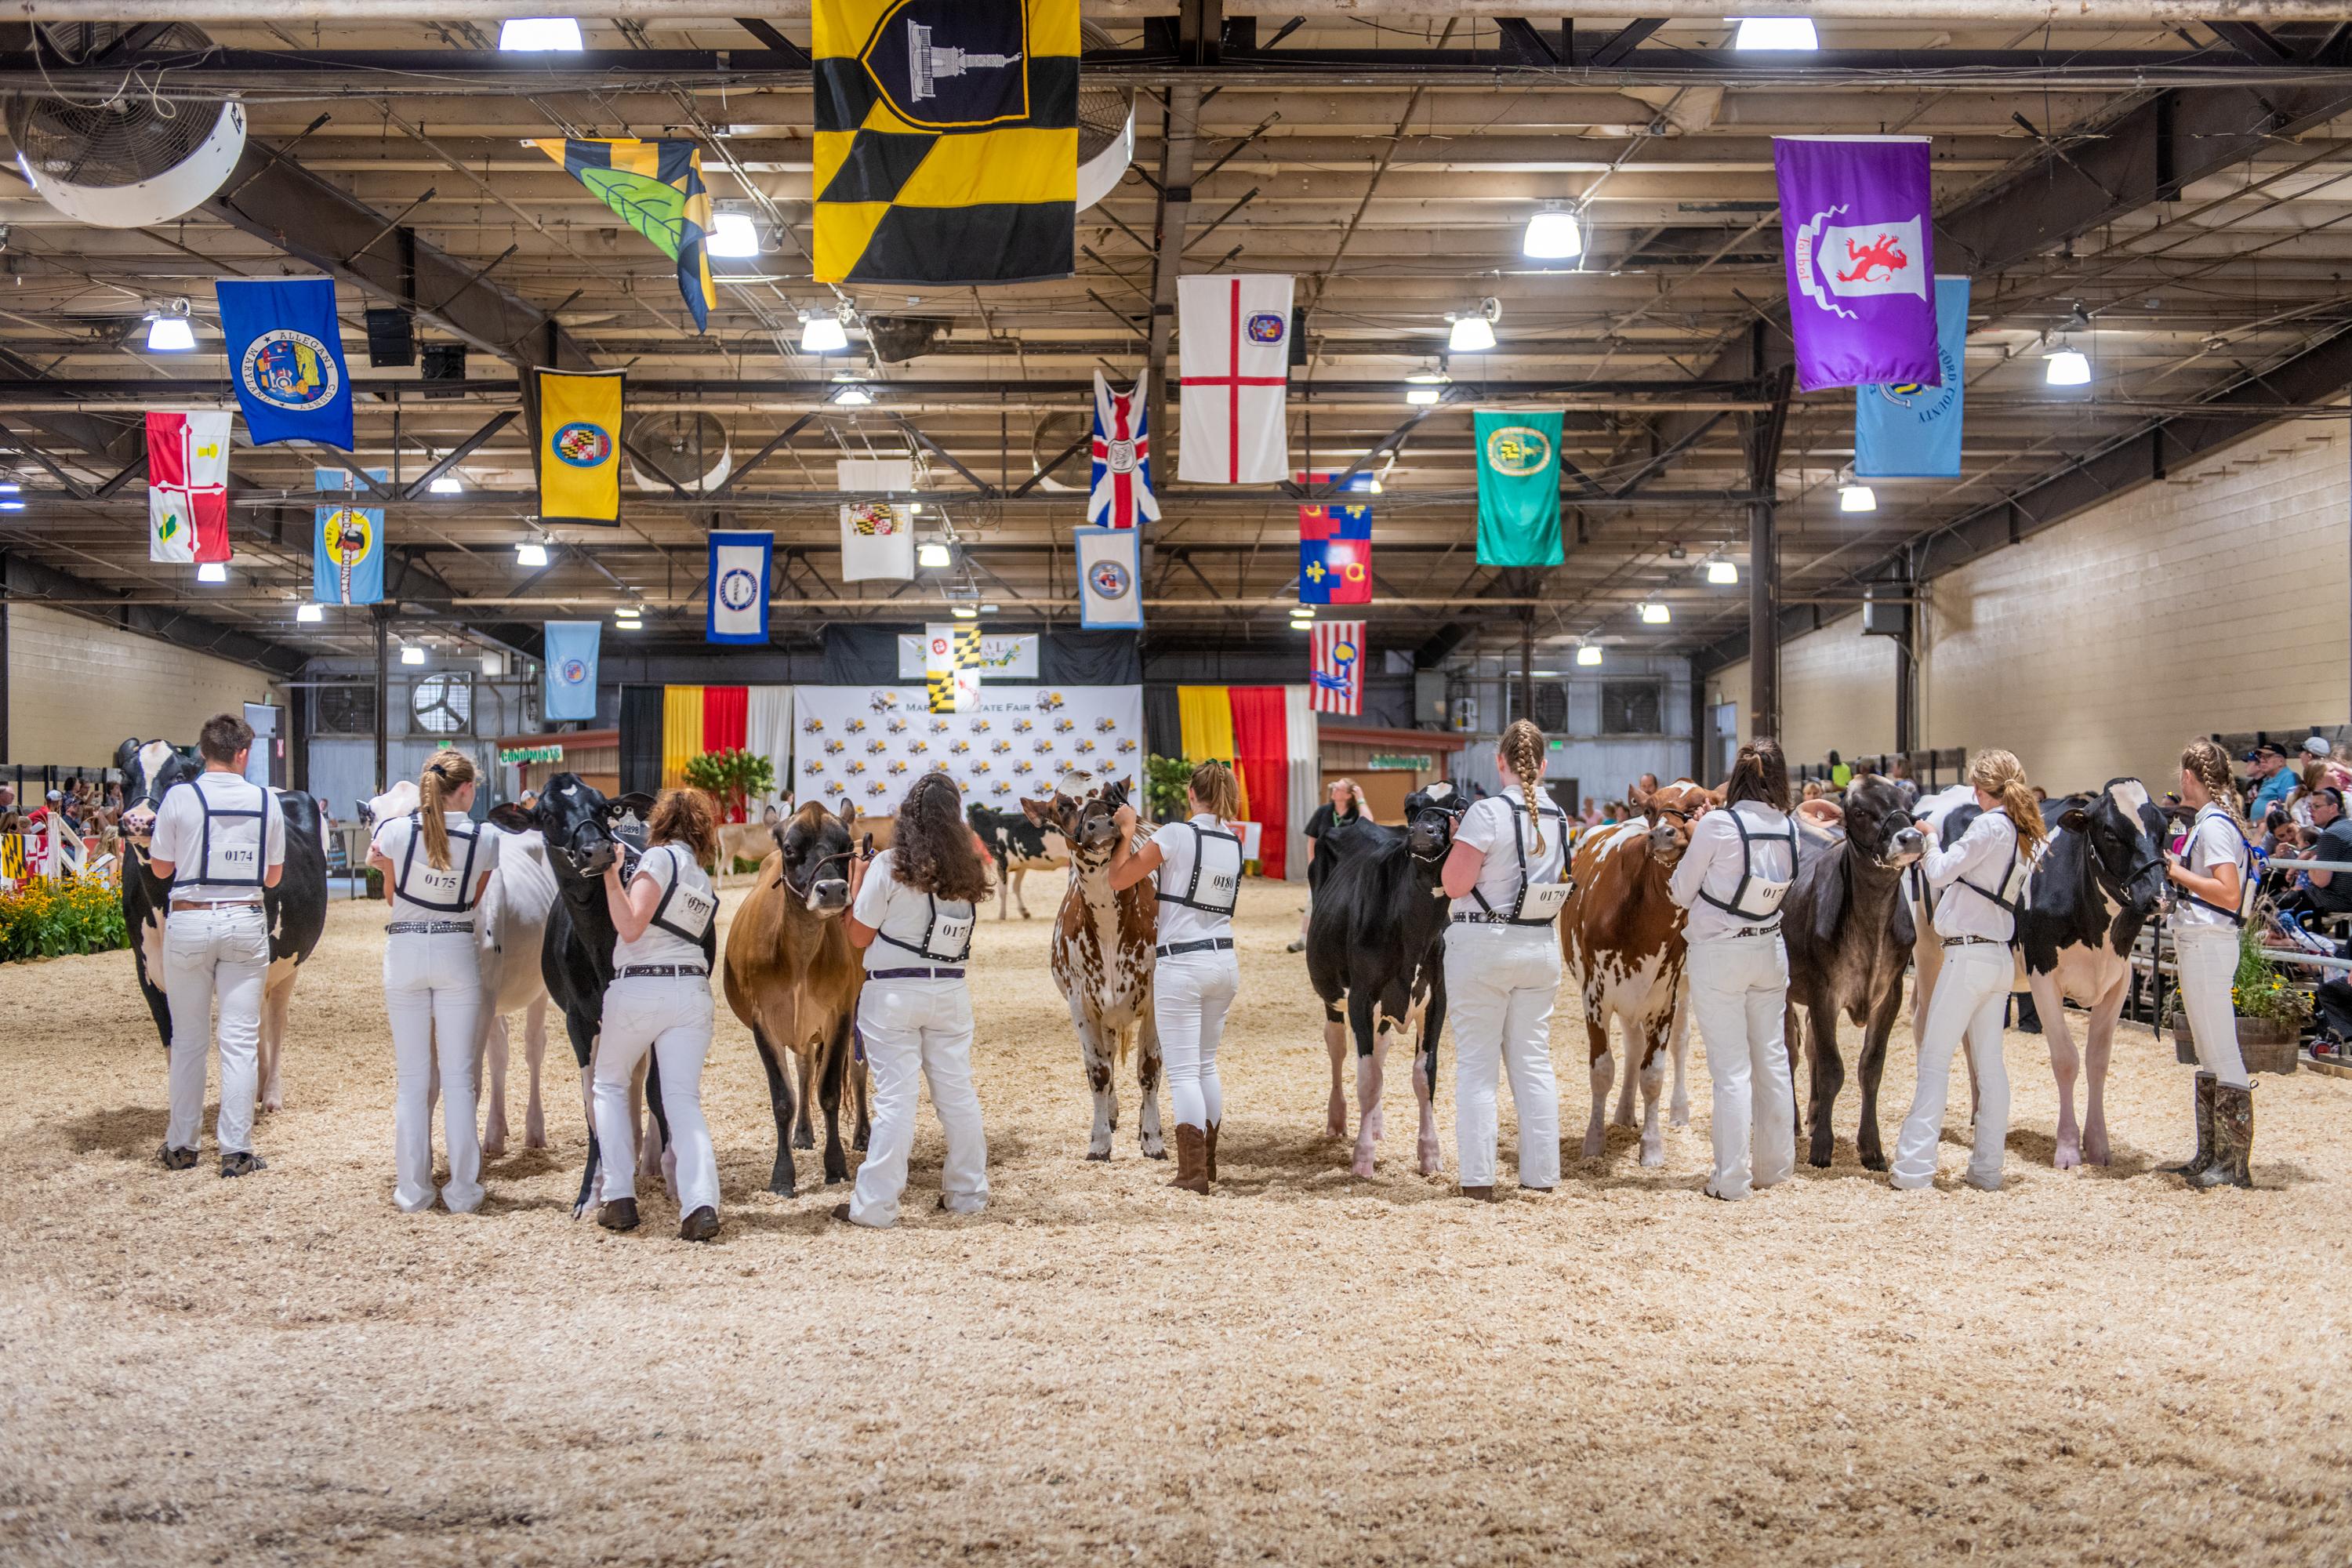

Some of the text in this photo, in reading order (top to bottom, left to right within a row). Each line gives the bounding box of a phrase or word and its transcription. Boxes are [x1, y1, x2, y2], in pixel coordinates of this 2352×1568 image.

[1797, 238, 1811, 281] Talbot
[244, 347, 271, 402] MARYLAND
[280, 332, 336, 409] ALLEGANY COUNTY
[1918, 344, 1957, 423] FORD COUNTY
[342, 480, 354, 594] WMICO COUNTY
[1005, 703, 1031, 712] FAIR
[501, 747, 561, 763] CONDIMENTS
[619, 824, 639, 834] 10898
[225, 850, 252, 862] 0174
[425, 873, 456, 888] 0175
[1214, 875, 1234, 889] 0180
[1540, 890, 1566, 902] 0179
